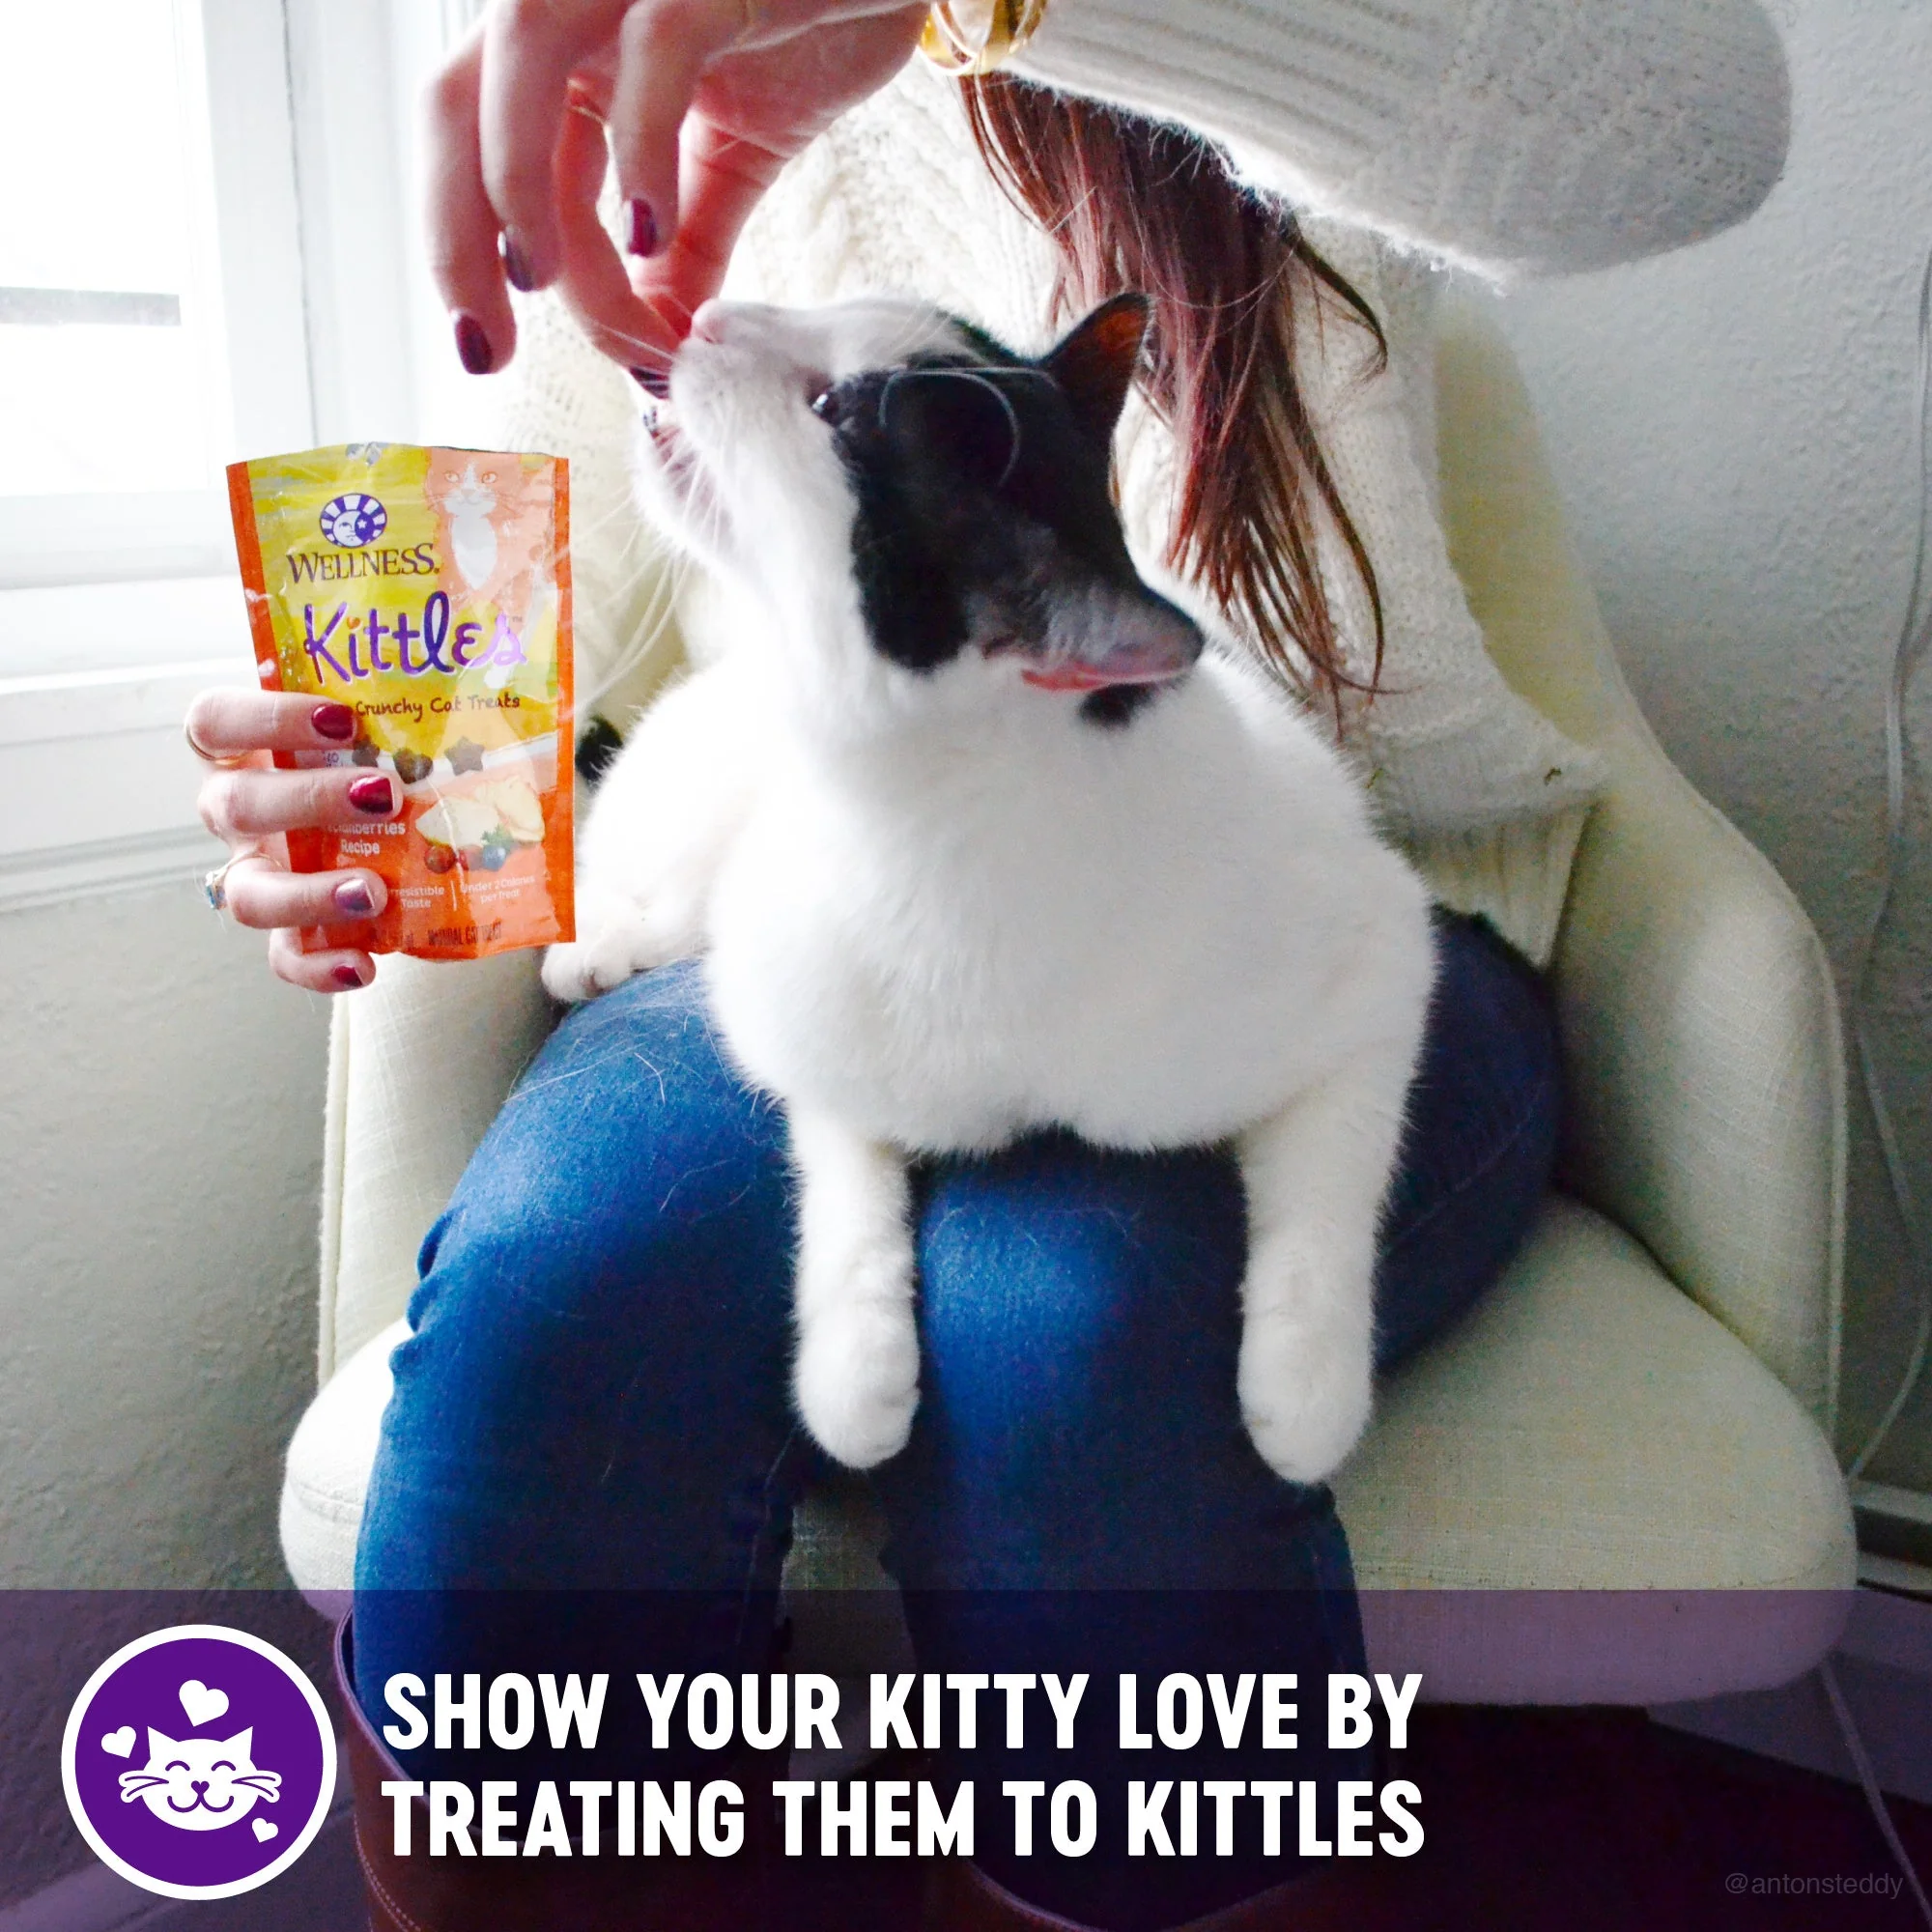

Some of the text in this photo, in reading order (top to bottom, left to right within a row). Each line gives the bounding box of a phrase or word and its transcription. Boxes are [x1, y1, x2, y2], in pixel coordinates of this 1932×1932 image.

[286, 543, 435, 583] WELLNESS
[303, 590, 527, 684] Kittles
[355, 692, 520, 723] Crunchy Cat Treats
[340, 838, 381, 857] Recipe
[389, 886, 445, 898] rresistible
[401, 898, 432, 909] Taste
